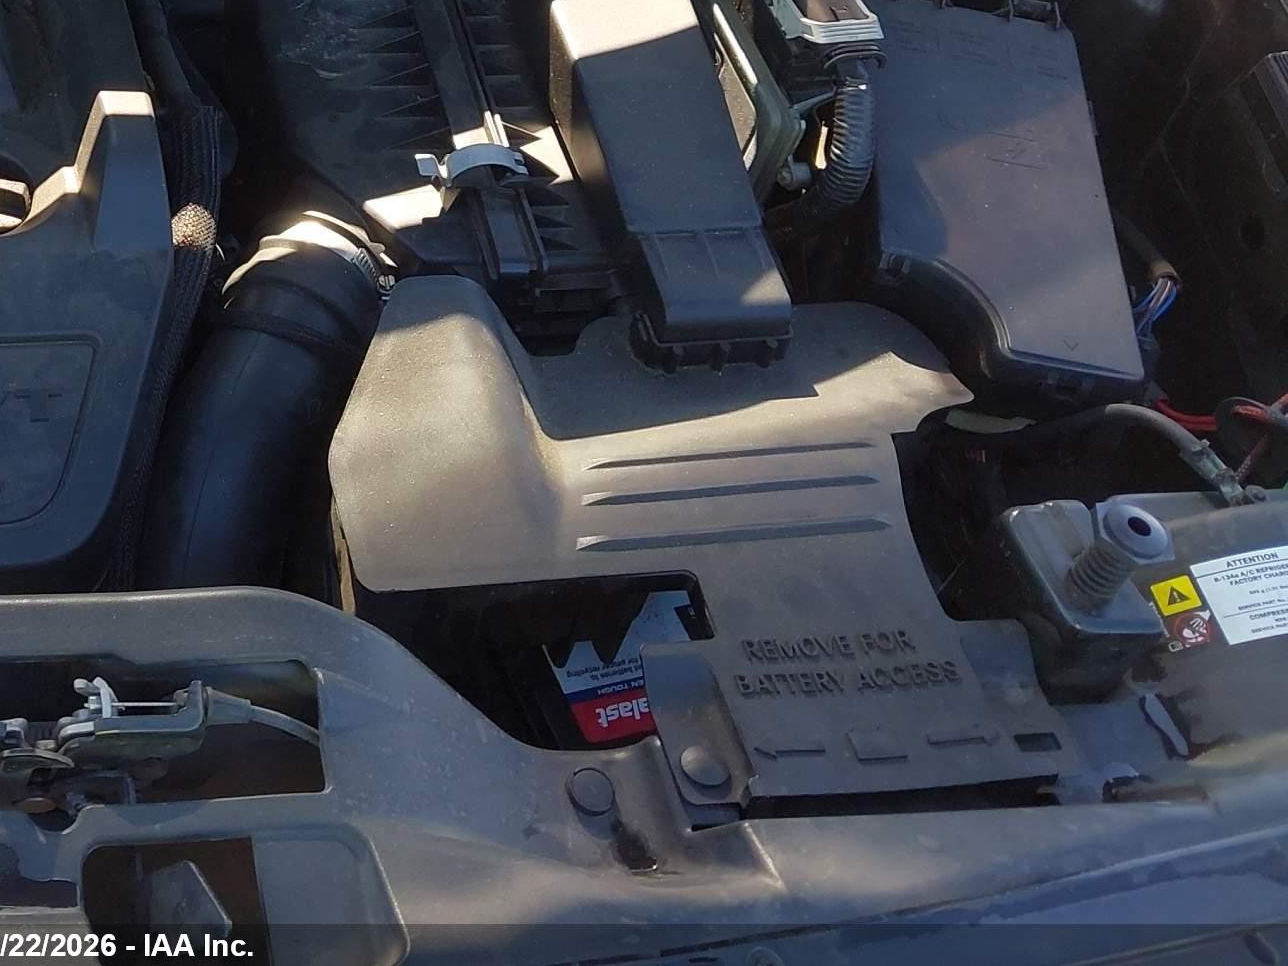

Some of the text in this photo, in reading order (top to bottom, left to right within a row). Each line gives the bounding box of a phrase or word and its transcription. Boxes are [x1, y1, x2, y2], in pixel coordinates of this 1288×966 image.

[1226, 552, 1279, 568] ATTENTION
[1229, 575, 1263, 586] FACTORY
[1240, 569, 1255, 578] A/C
[740, 629, 916, 662] REMOVE FOR
[566, 666, 600, 678] recycling
[734, 659, 961, 698] BATTERY ACCESS
